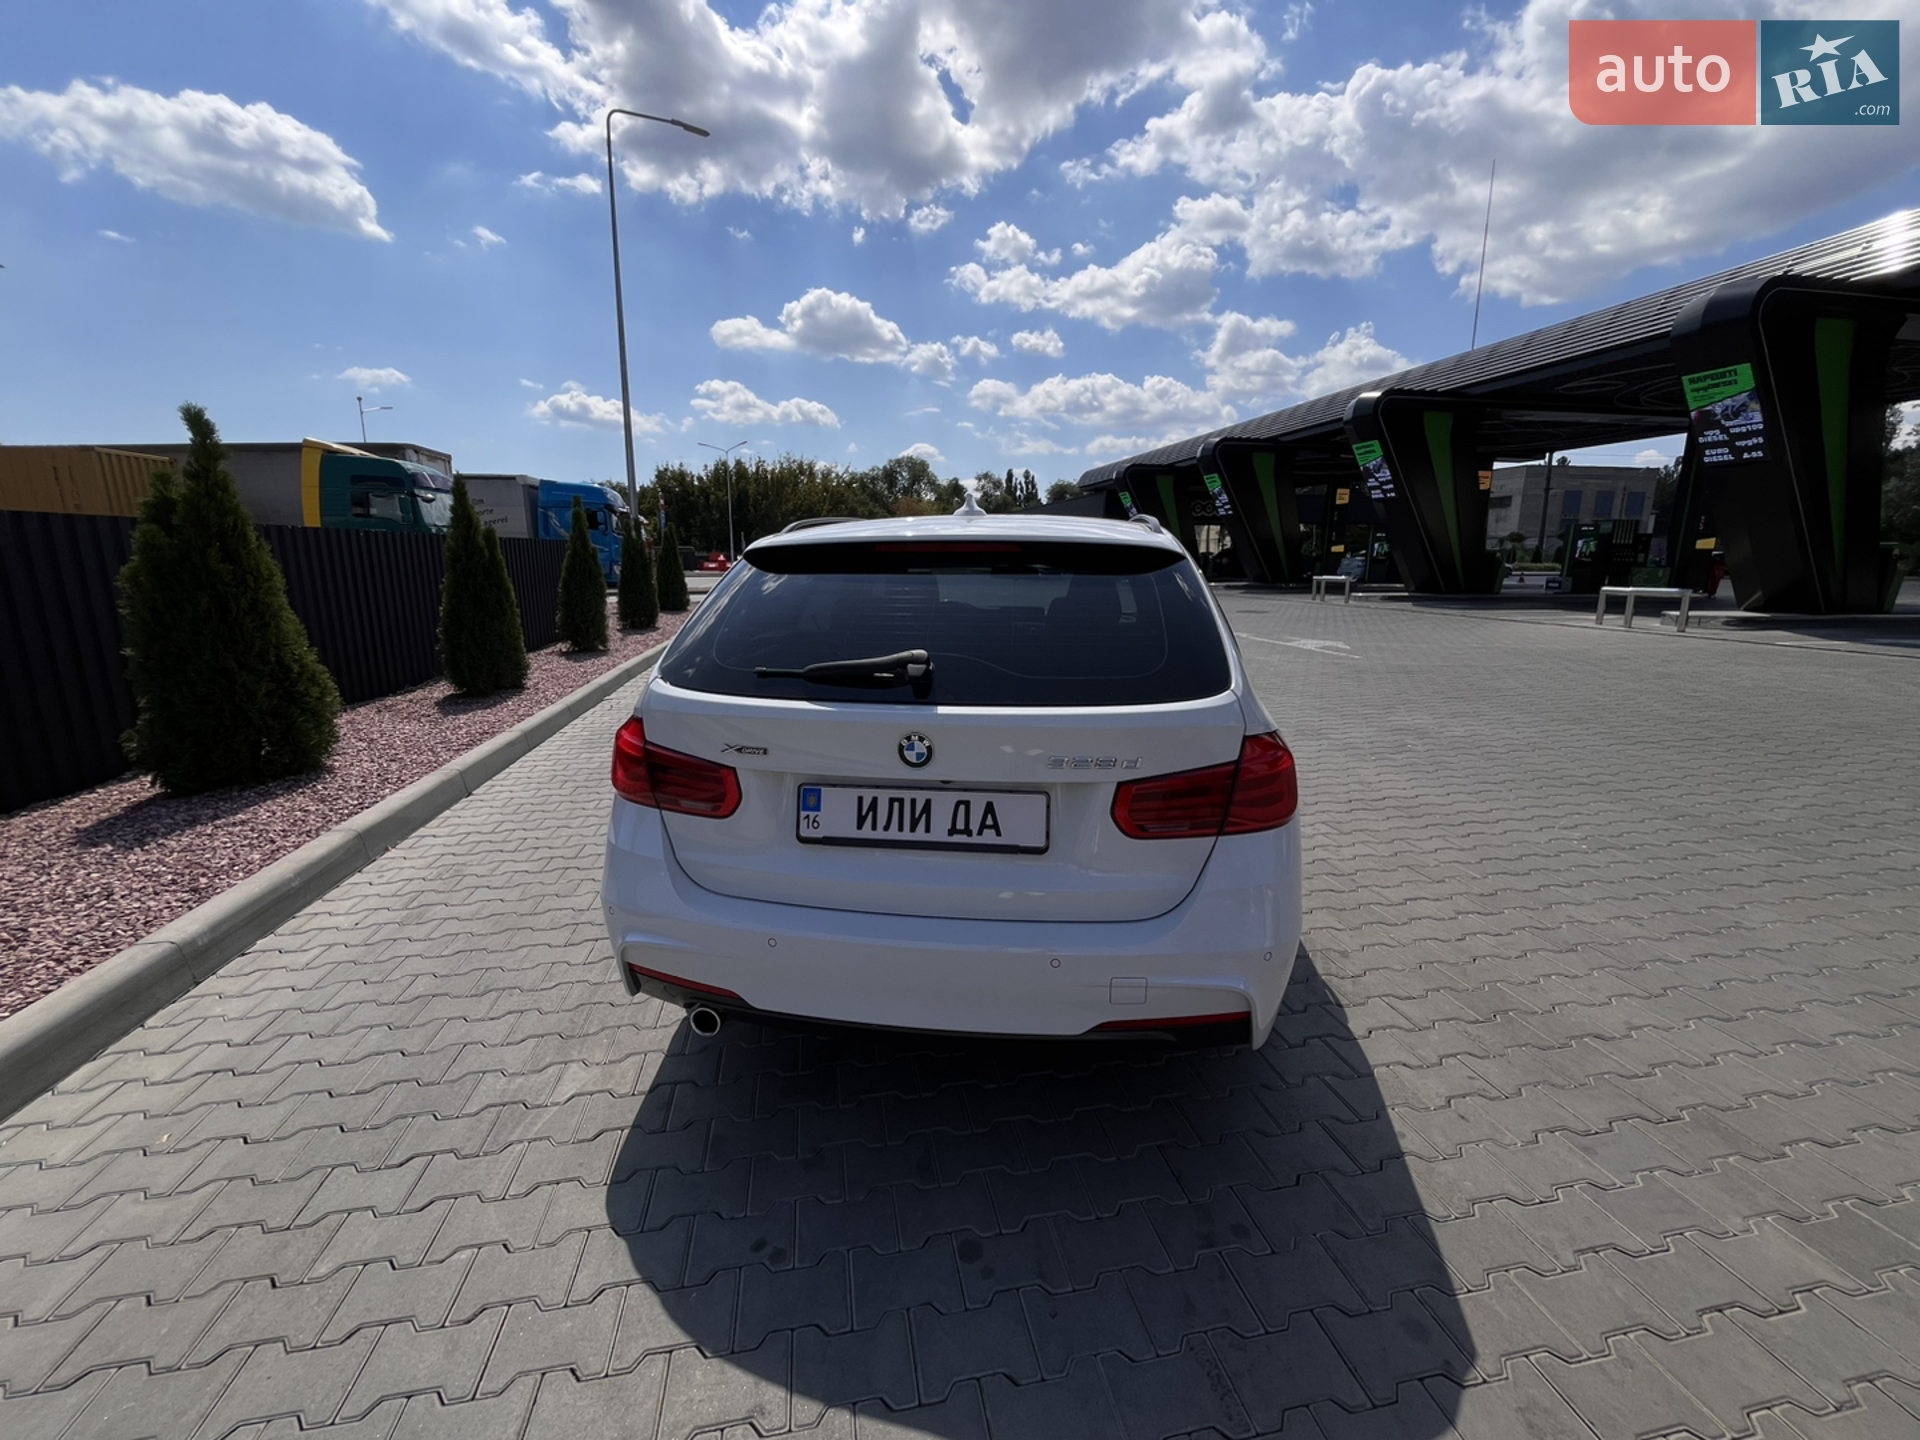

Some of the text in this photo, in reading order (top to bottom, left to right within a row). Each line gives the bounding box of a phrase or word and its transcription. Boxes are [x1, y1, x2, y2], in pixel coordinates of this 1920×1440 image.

[1698, 434, 1729, 443] DIESEL
[1704, 447, 1729, 456] EURO
[1703, 454, 1734, 463] DIESEL
[856, 795, 1002, 838] ИЛИ ДА
[802, 813, 821, 830] 16
